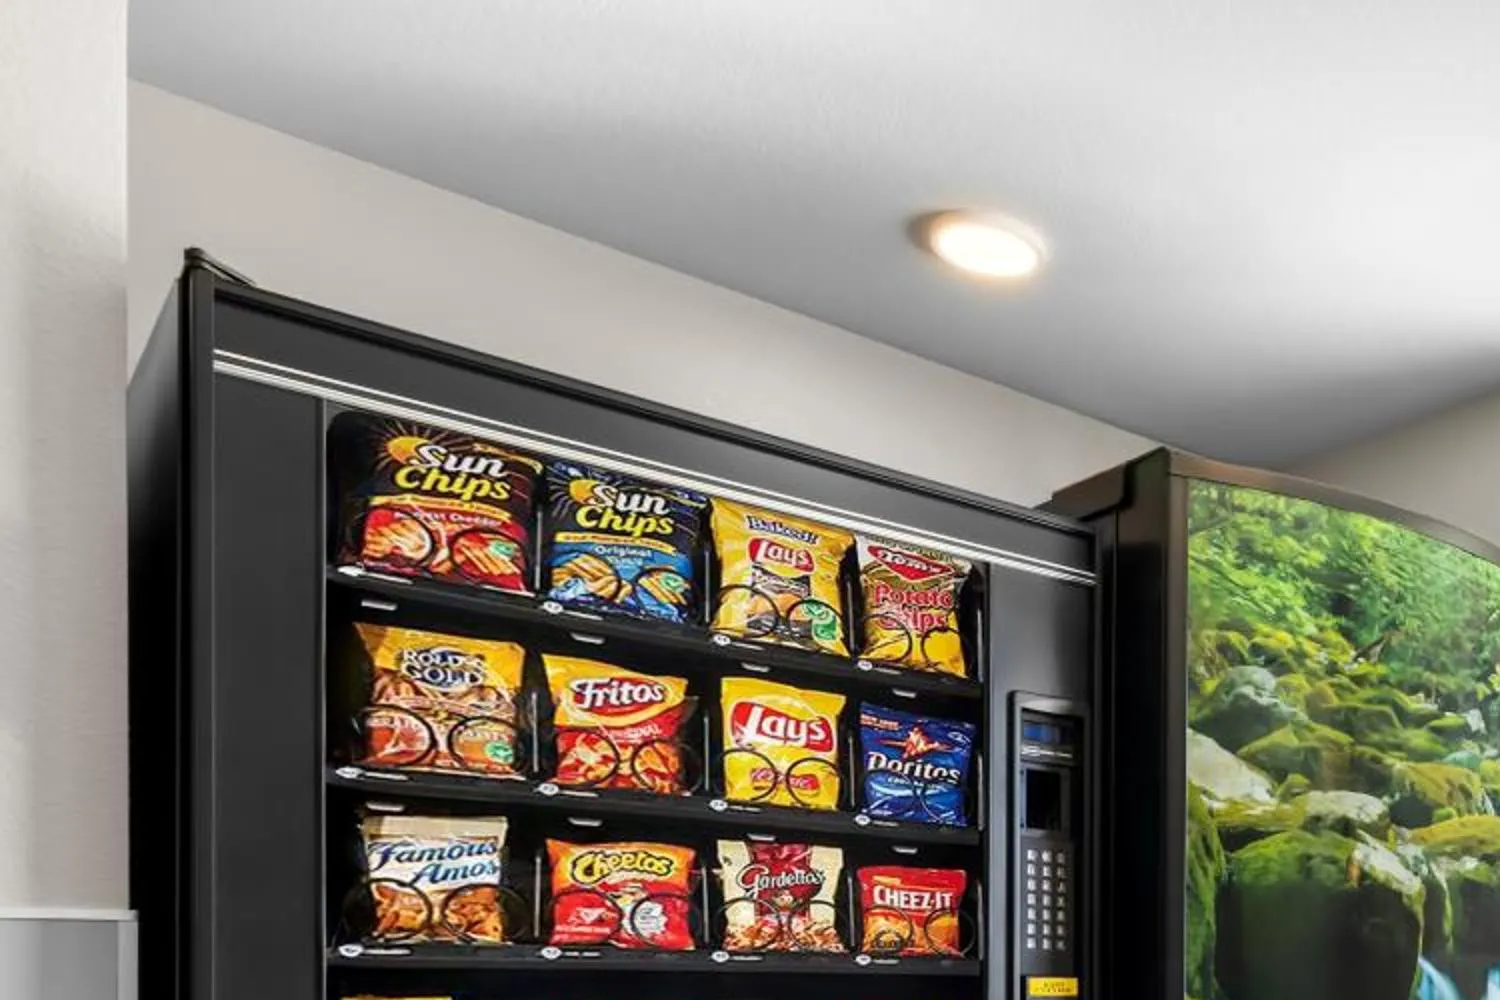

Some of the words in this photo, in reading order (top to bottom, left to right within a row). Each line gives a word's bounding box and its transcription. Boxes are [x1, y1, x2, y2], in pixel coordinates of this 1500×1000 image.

[410, 444, 509, 478] Sun
[394, 465, 511, 501] Chips
[586, 484, 672, 515] Sun
[575, 504, 675, 538] Chips
[400, 662, 484, 683] GOLD
[569, 678, 665, 709] Fritos
[867, 750, 961, 780] Doritos
[367, 840, 497, 872] Famous
[571, 850, 674, 885] Cheetos
[410, 860, 498, 885] Amos
